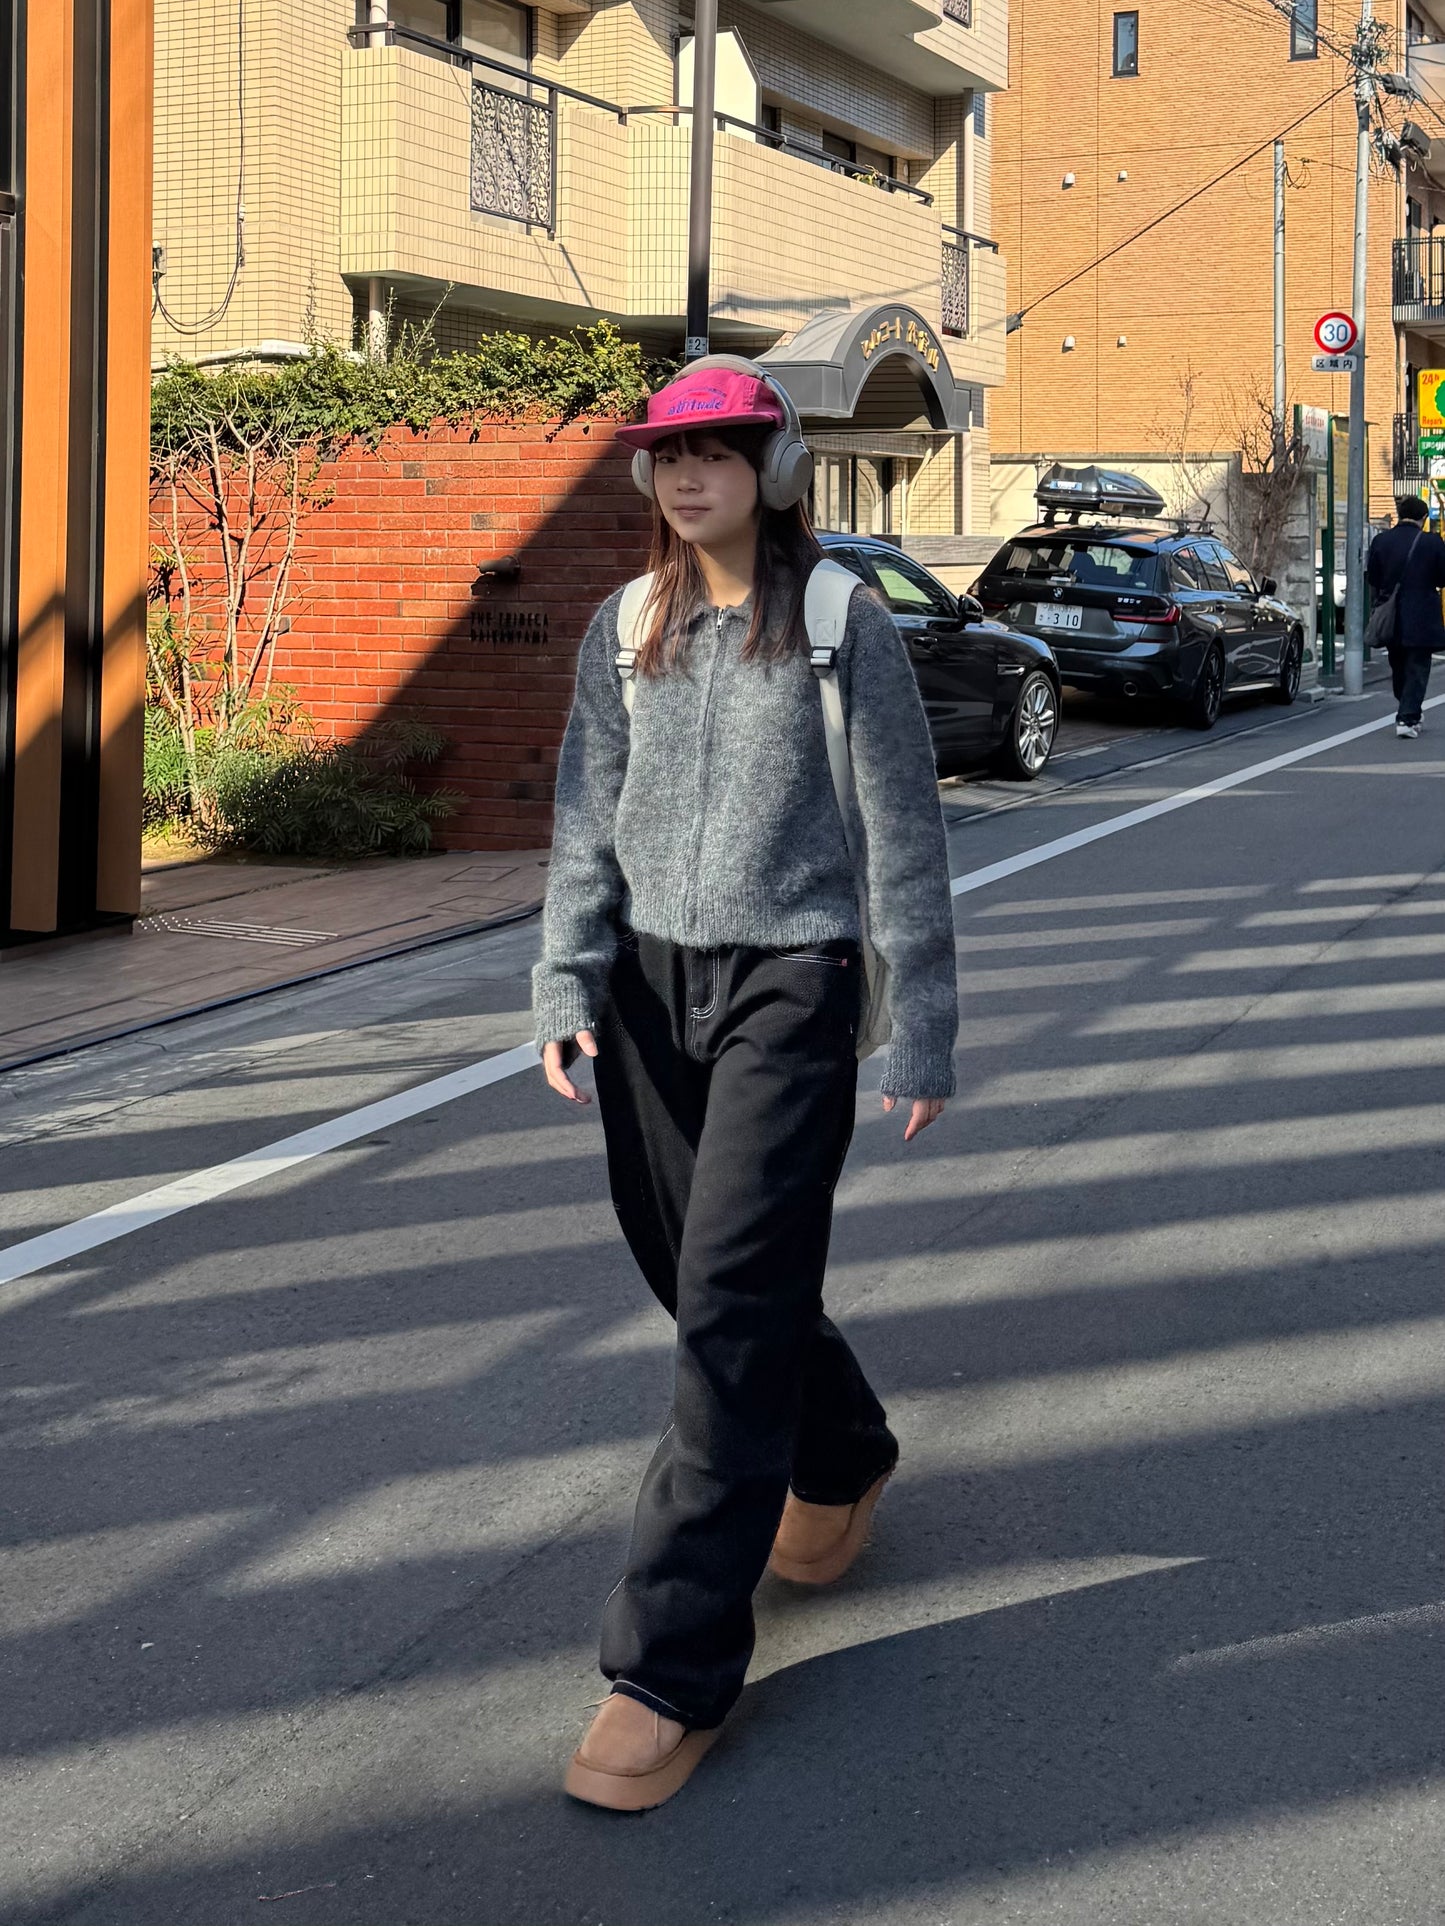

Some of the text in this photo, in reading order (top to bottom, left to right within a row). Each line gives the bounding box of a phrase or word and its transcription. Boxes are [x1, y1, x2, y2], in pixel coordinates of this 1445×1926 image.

[861, 316, 901, 360] ヒルコート
[1324, 323, 1348, 342] 30
[1315, 358, 1353, 369] 区域内
[471, 611, 549, 627] THE TRIBECA
[471, 628, 549, 644] DAIKANYAMA
